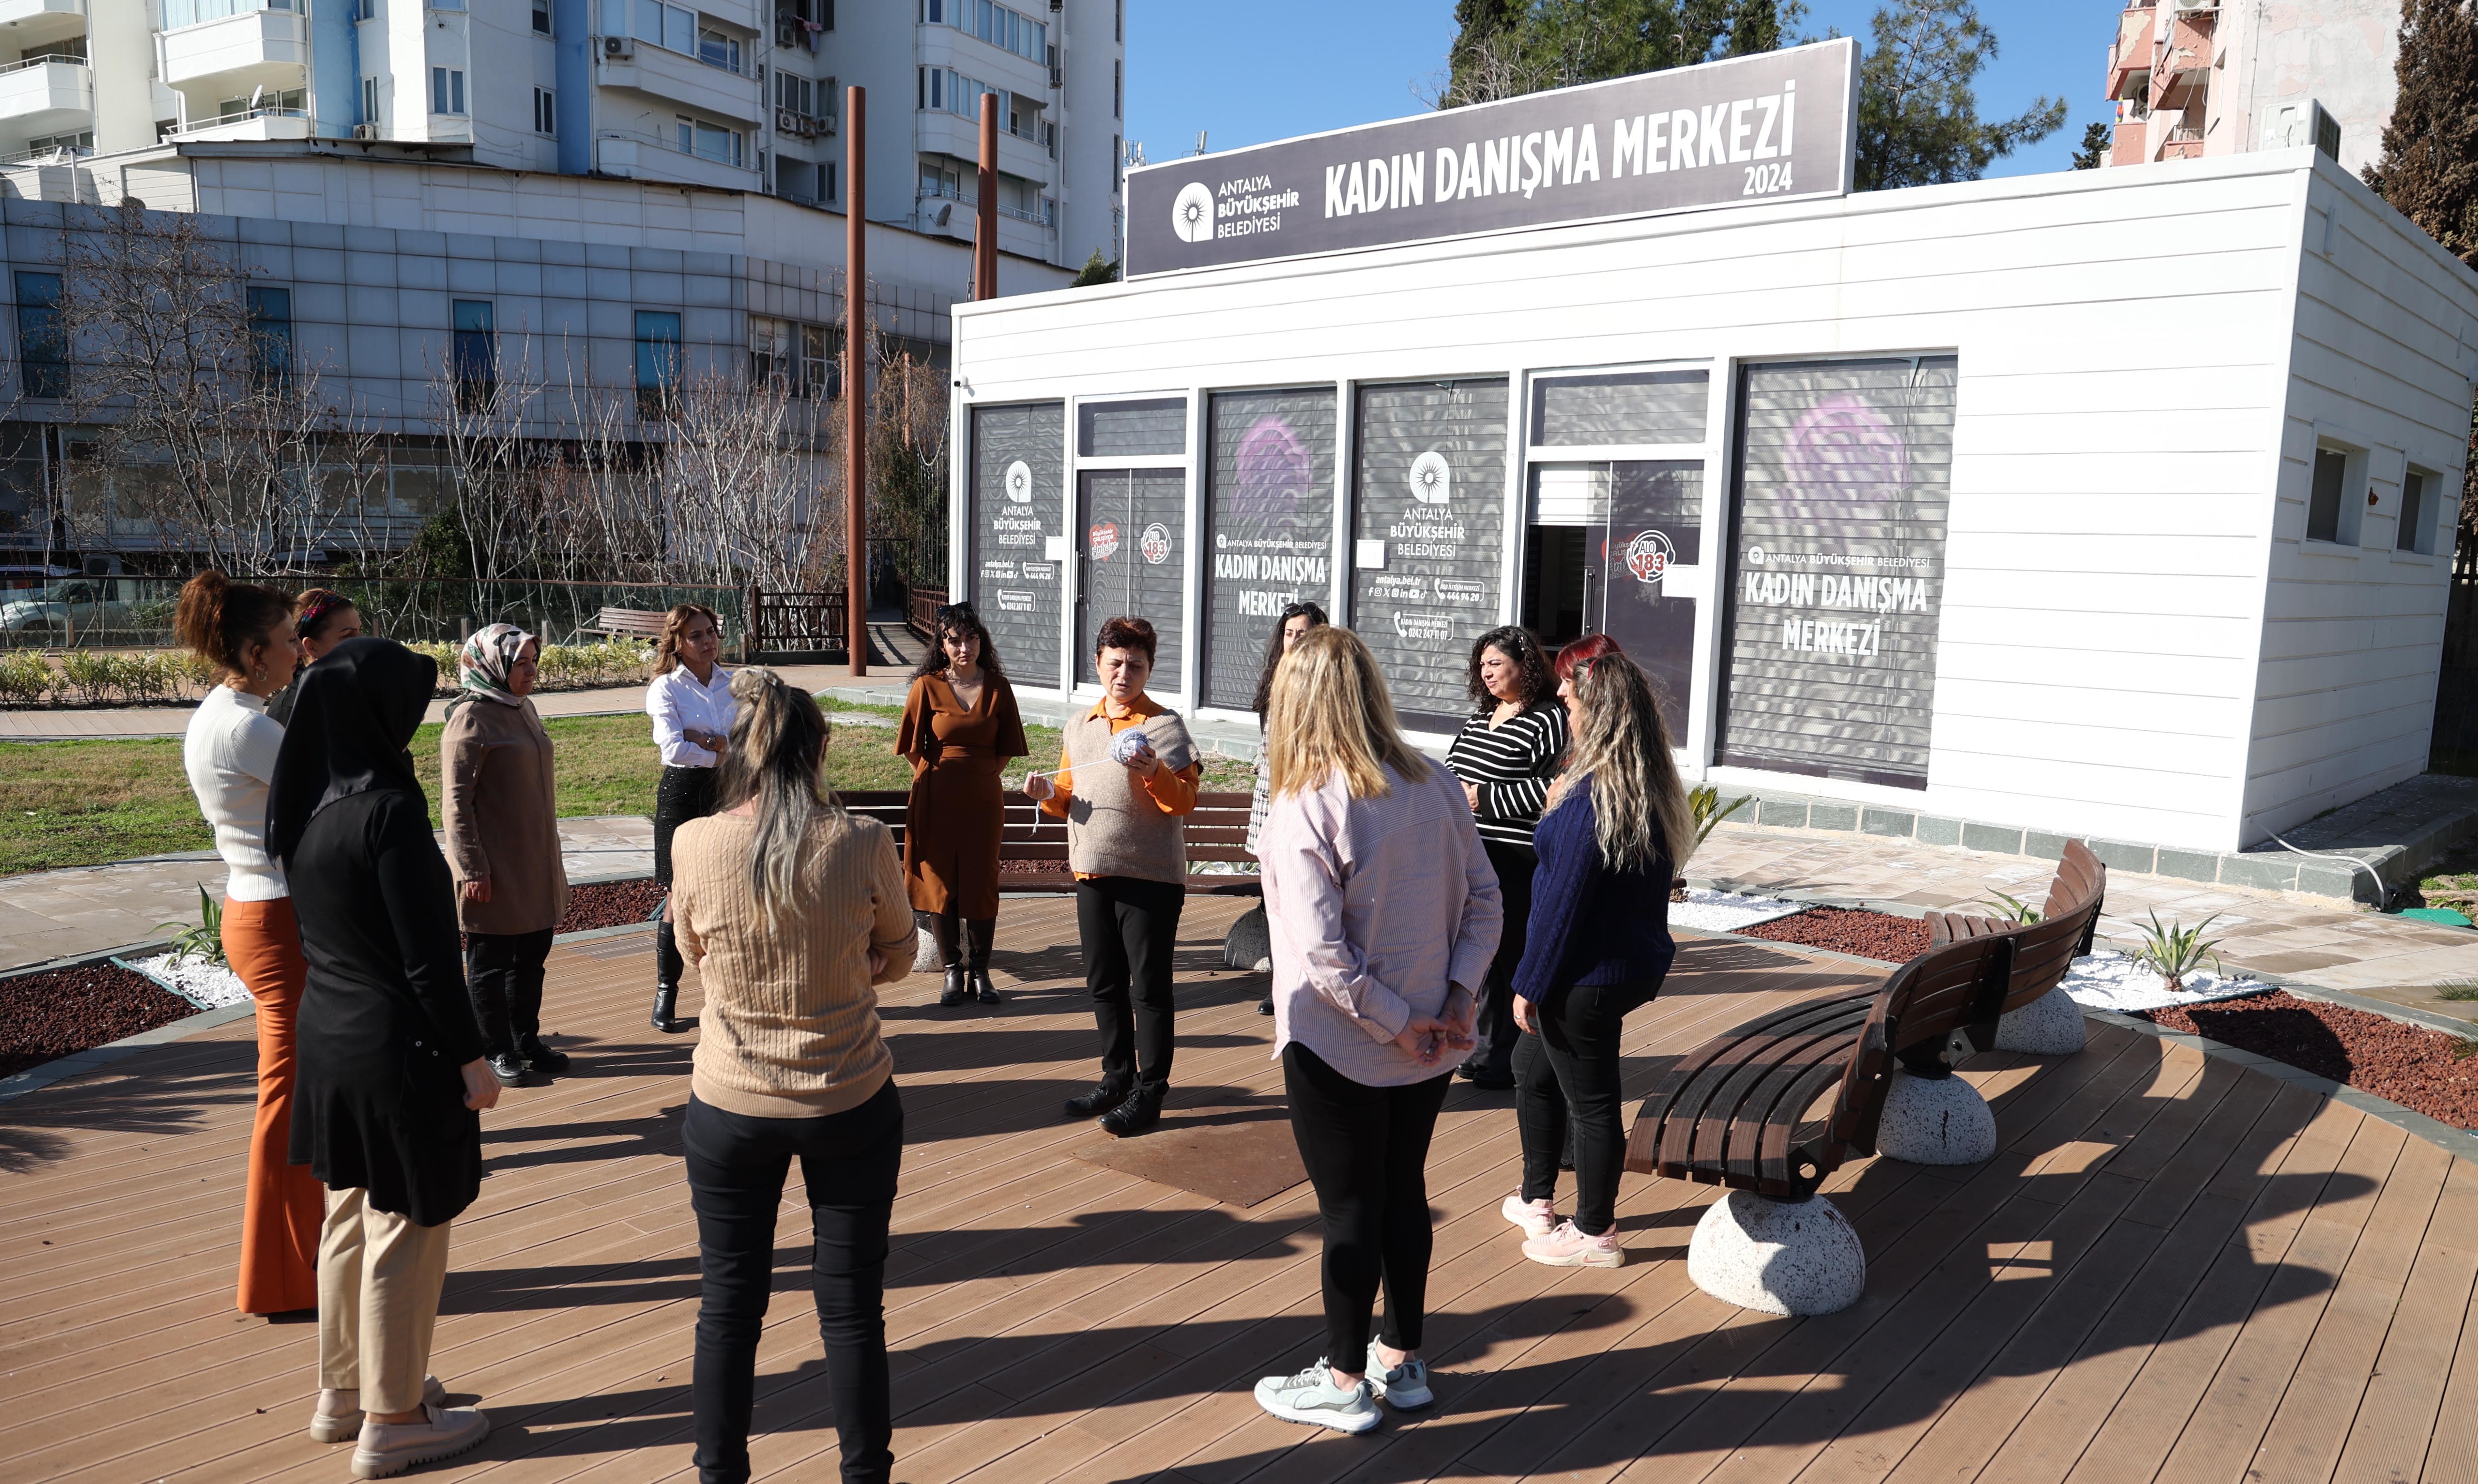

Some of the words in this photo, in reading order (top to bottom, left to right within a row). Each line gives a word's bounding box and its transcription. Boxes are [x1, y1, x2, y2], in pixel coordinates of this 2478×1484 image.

[1325, 151, 1424, 218] KADIN
[1435, 123, 1600, 199] DANIŞMA
[1612, 79, 1796, 178] MERKEZİ
[1218, 174, 1271, 197] ANTALYA
[1743, 162, 1792, 195] 2024
[1218, 188, 1299, 218] BÜYÜKŞEHİR
[1218, 212, 1280, 238] BELEDİYESİ
[1002, 505, 1033, 516] ANTALYA
[1403, 507, 1453, 520] ANTALYA
[994, 517, 1041, 532] BÜYÜKŞEHİR
[1390, 522, 1465, 541] BÜYÜKŞEHİR
[999, 532, 1036, 544] BELEDİYESİ
[1149, 532, 1159, 541] ALO
[1254, 538, 1294, 550] BÜYÜKŞEHİR
[1295, 540, 1326, 549] BELEDİYESİ
[1092, 539, 1118, 556] Antalya
[1147, 542, 1165, 555] 183
[1398, 541, 1456, 557] BELEDİYESİ
[1640, 542, 1655, 553] ALO
[985, 560, 1014, 569] antalya.bel.tr
[1636, 554, 1665, 571] 183
[1766, 554, 1807, 563] ANTALYA
[1810, 552, 1874, 567] BÜYÜKŞEHİR
[1877, 556, 1930, 568] BELEDİYESİ
[1215, 554, 1258, 579] KADIN
[1262, 556, 1326, 585] DANIŞMA
[1376, 575, 1421, 586] antalya.bel.tr
[1447, 592, 1460, 600] 444
[1470, 593, 1480, 602] 20
[1745, 572, 1815, 605] KADIN
[1821, 574, 1927, 614] DANIŞMA
[1413, 619, 1430, 627] DANIŞMA
[1431, 620, 1448, 628] MERKEZİ
[1408, 628, 1422, 638] 0242
[1423, 629, 1433, 639] 247
[1435, 630, 1439, 639] 11
[1440, 630, 1447, 640] 07
[1782, 618, 1881, 656] MERKEZİ
